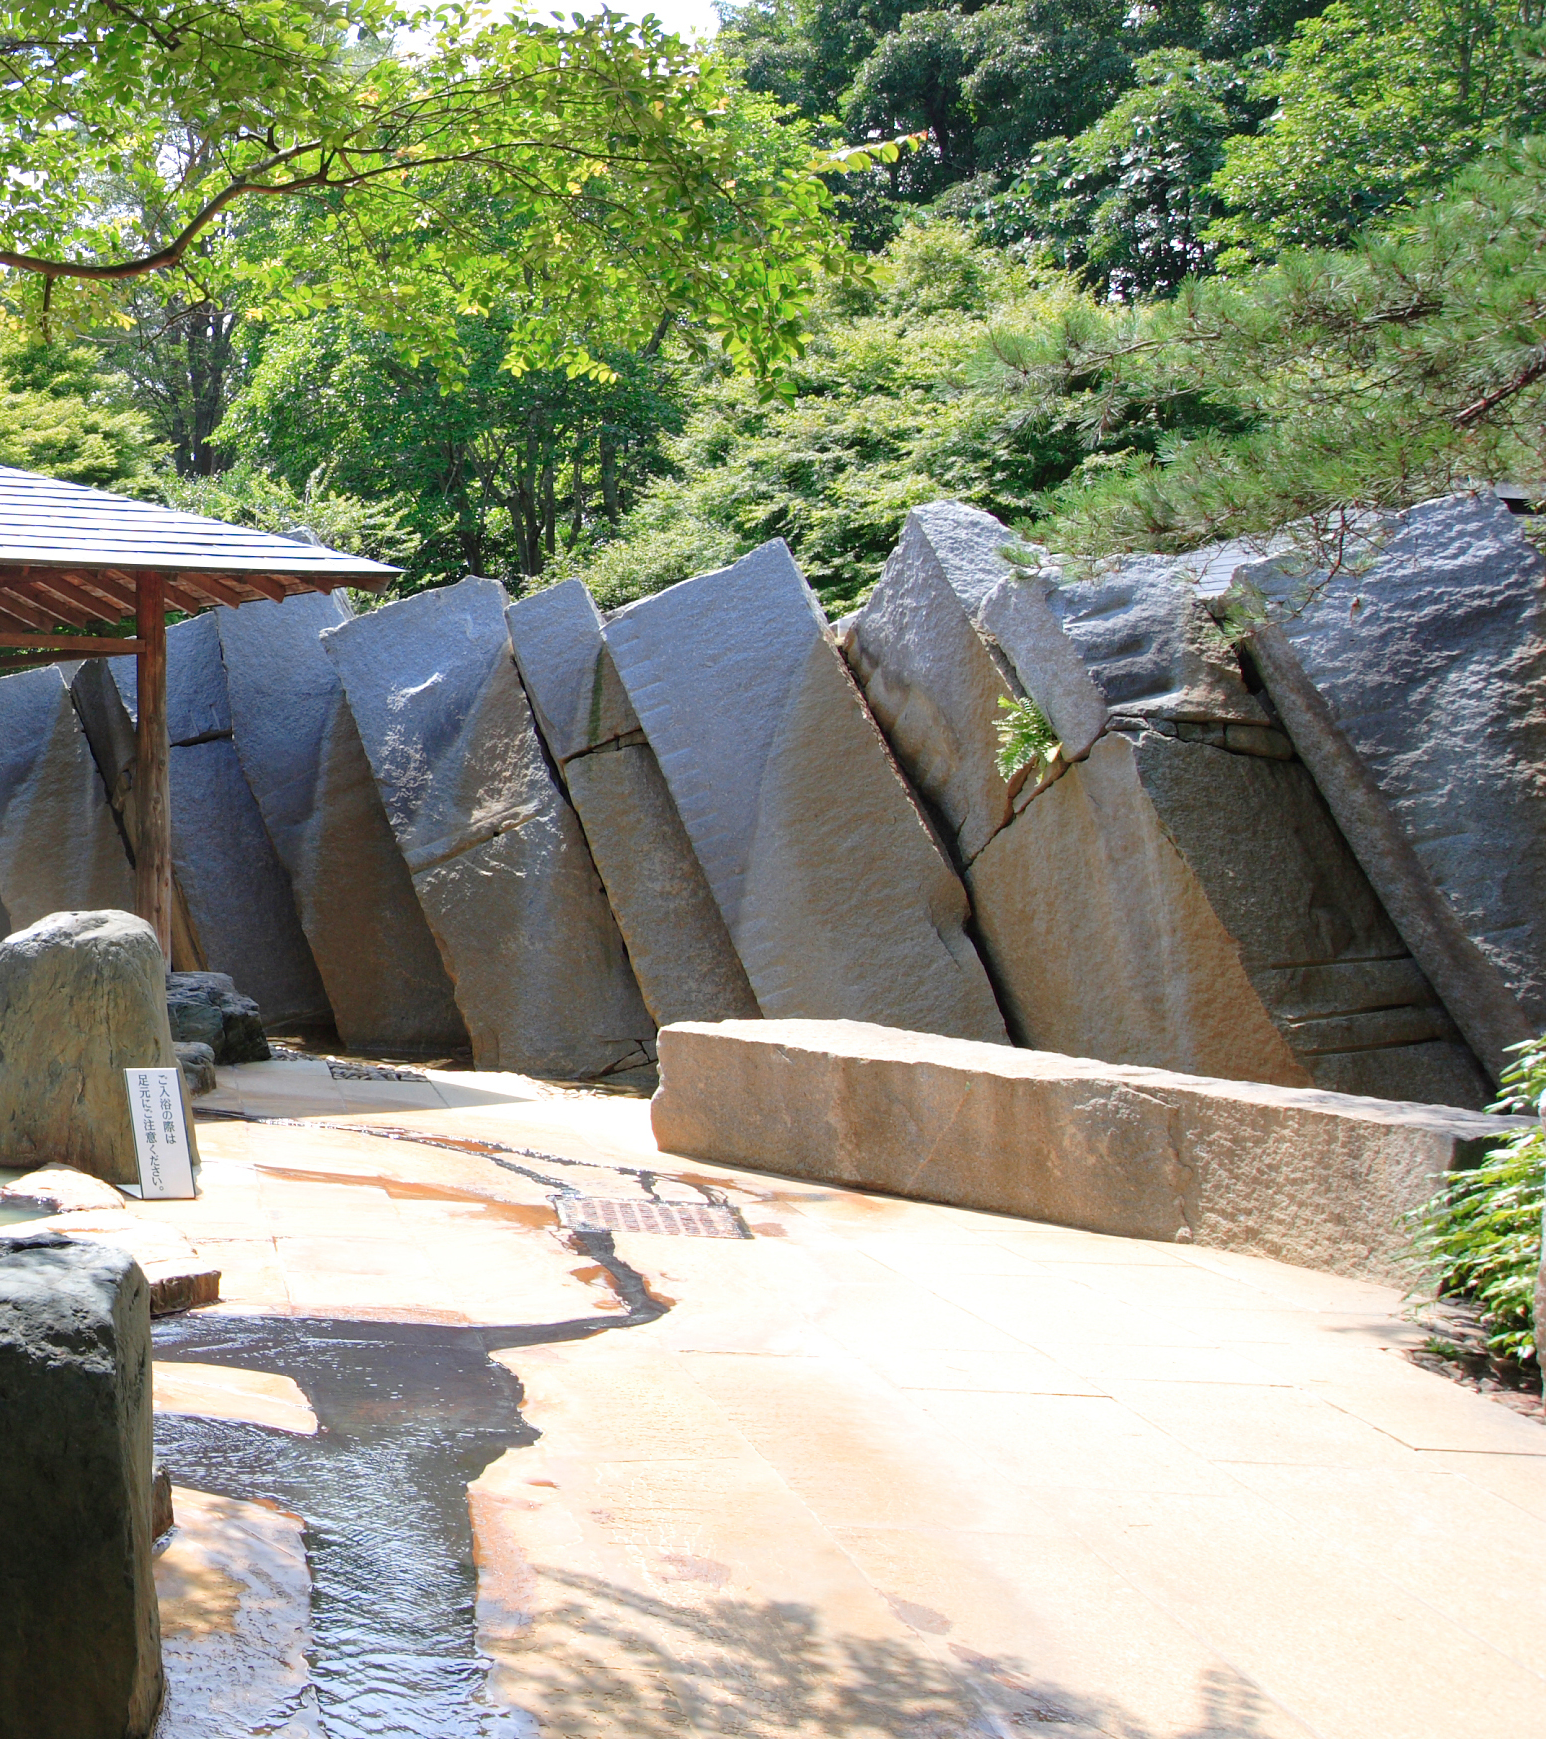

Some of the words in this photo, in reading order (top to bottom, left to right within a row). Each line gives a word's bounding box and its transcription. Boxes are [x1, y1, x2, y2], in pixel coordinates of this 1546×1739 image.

[138, 1074, 165, 1192] 足元にご注意ください。
[157, 1074, 177, 1145] ご入浴の際は
